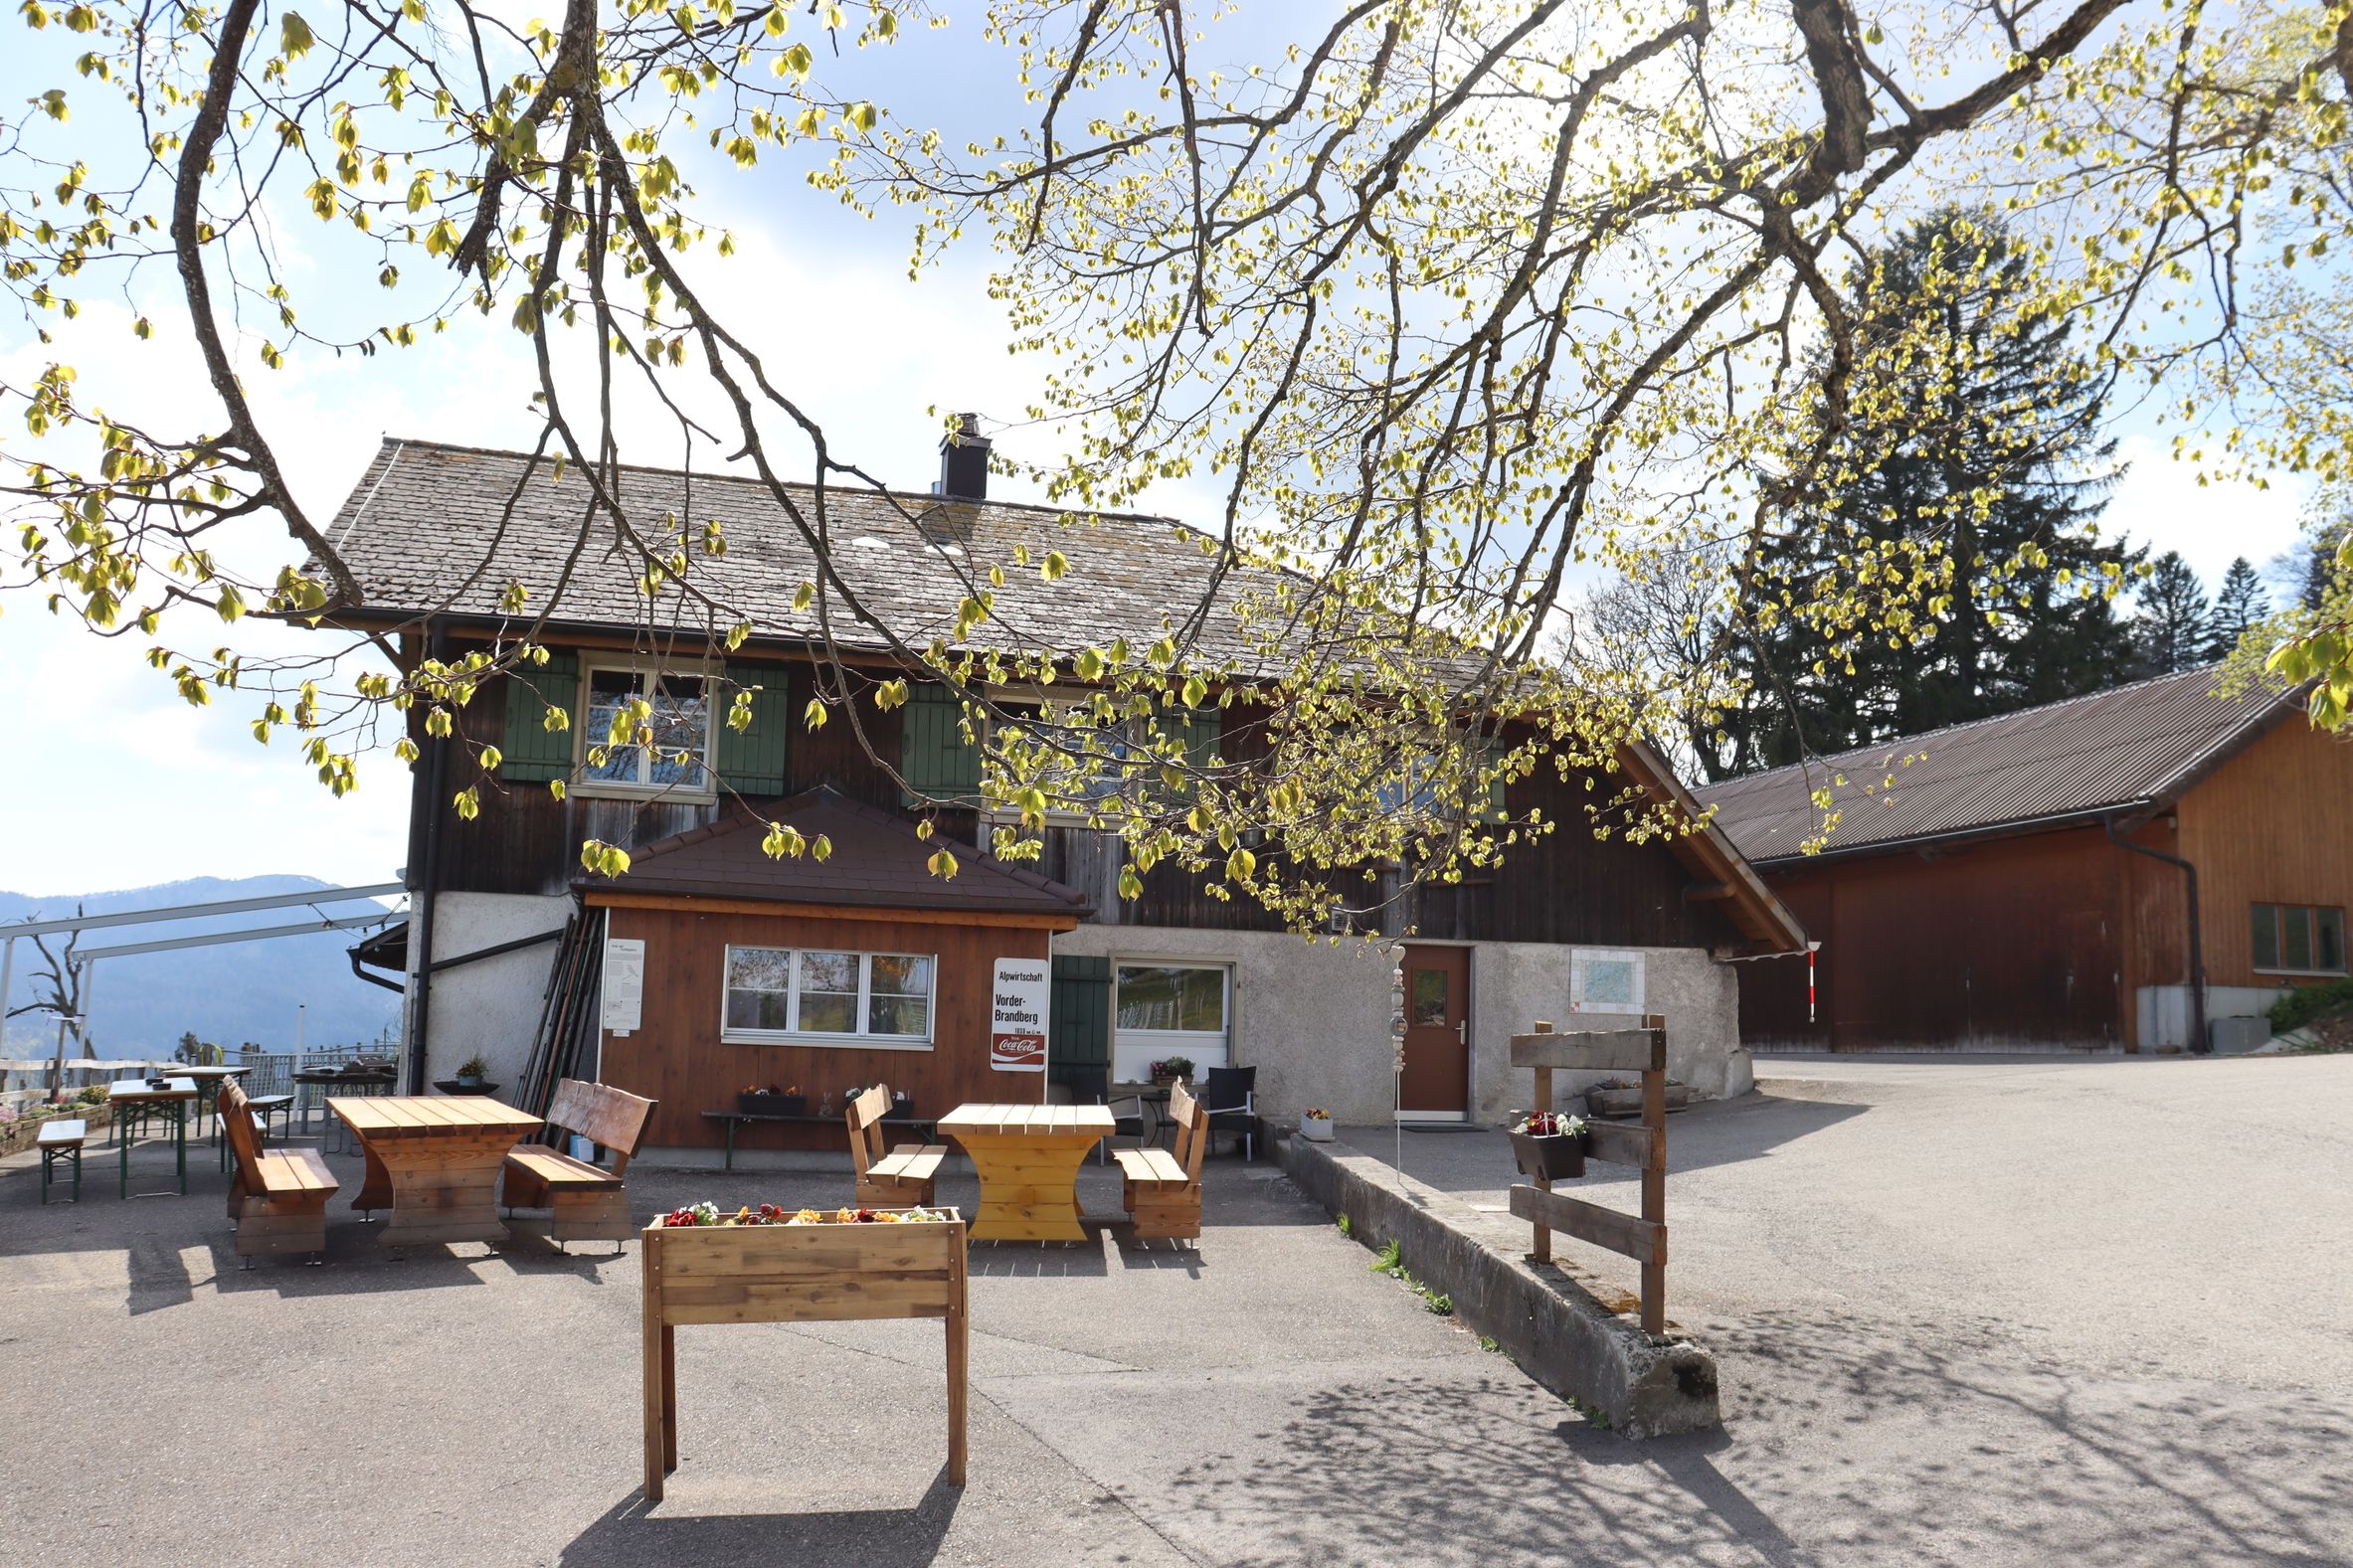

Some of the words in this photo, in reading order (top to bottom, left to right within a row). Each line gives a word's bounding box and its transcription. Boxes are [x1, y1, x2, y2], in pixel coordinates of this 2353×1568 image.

[999, 971, 1043, 982] Alpwirtschaft
[996, 994, 1025, 1006] Vorder-
[995, 1009, 1038, 1025] Brandberg
[998, 1039, 1037, 1052] Coca-Cola
